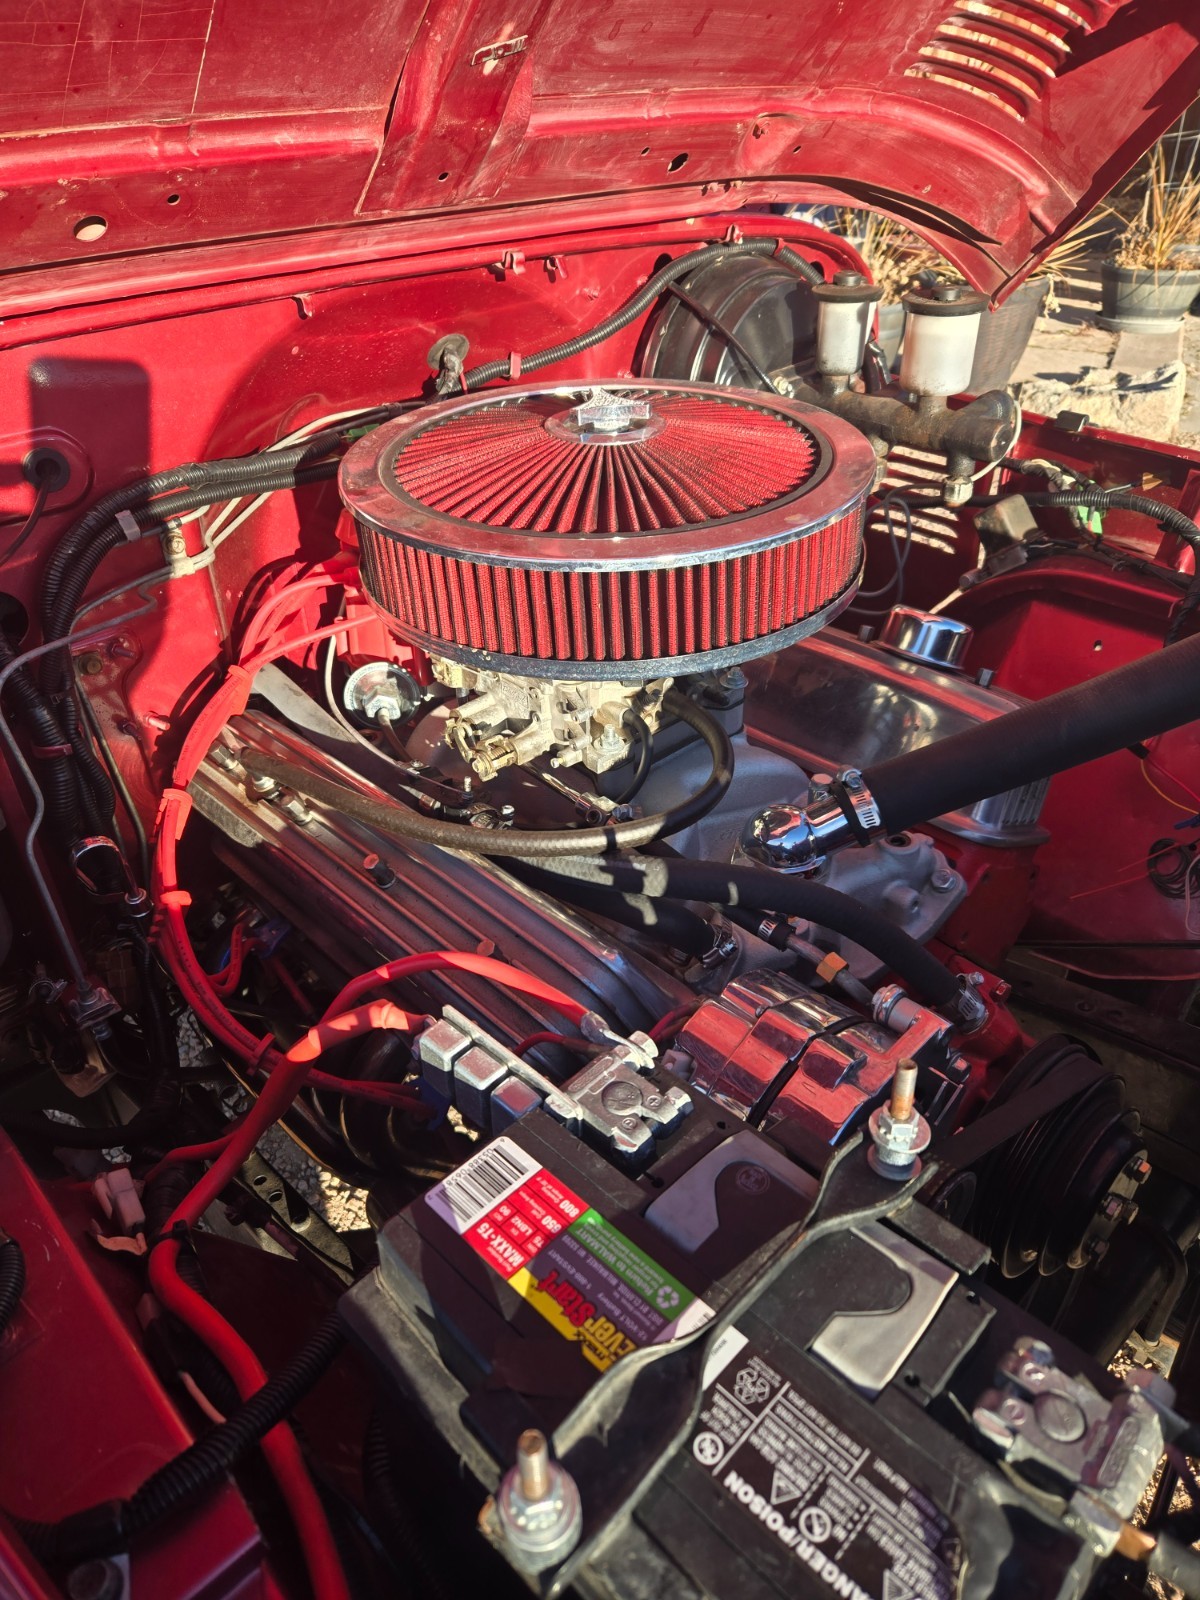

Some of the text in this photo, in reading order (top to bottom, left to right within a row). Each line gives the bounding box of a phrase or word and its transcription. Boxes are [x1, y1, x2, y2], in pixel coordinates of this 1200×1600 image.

[467, 1146, 494, 1169] 05388
[497, 1202, 512, 1217] 90
[557, 1197, 580, 1219] 800
[509, 1213, 534, 1236] LBN2
[539, 1212, 563, 1235] 650
[473, 1219, 527, 1268] MAXX-T5
[531, 1233, 546, 1248] T5
[574, 1225, 654, 1296] Return to WALMART
[534, 1268, 637, 1361] EverStart
[722, 1468, 874, 1600] ANGER/POISON
